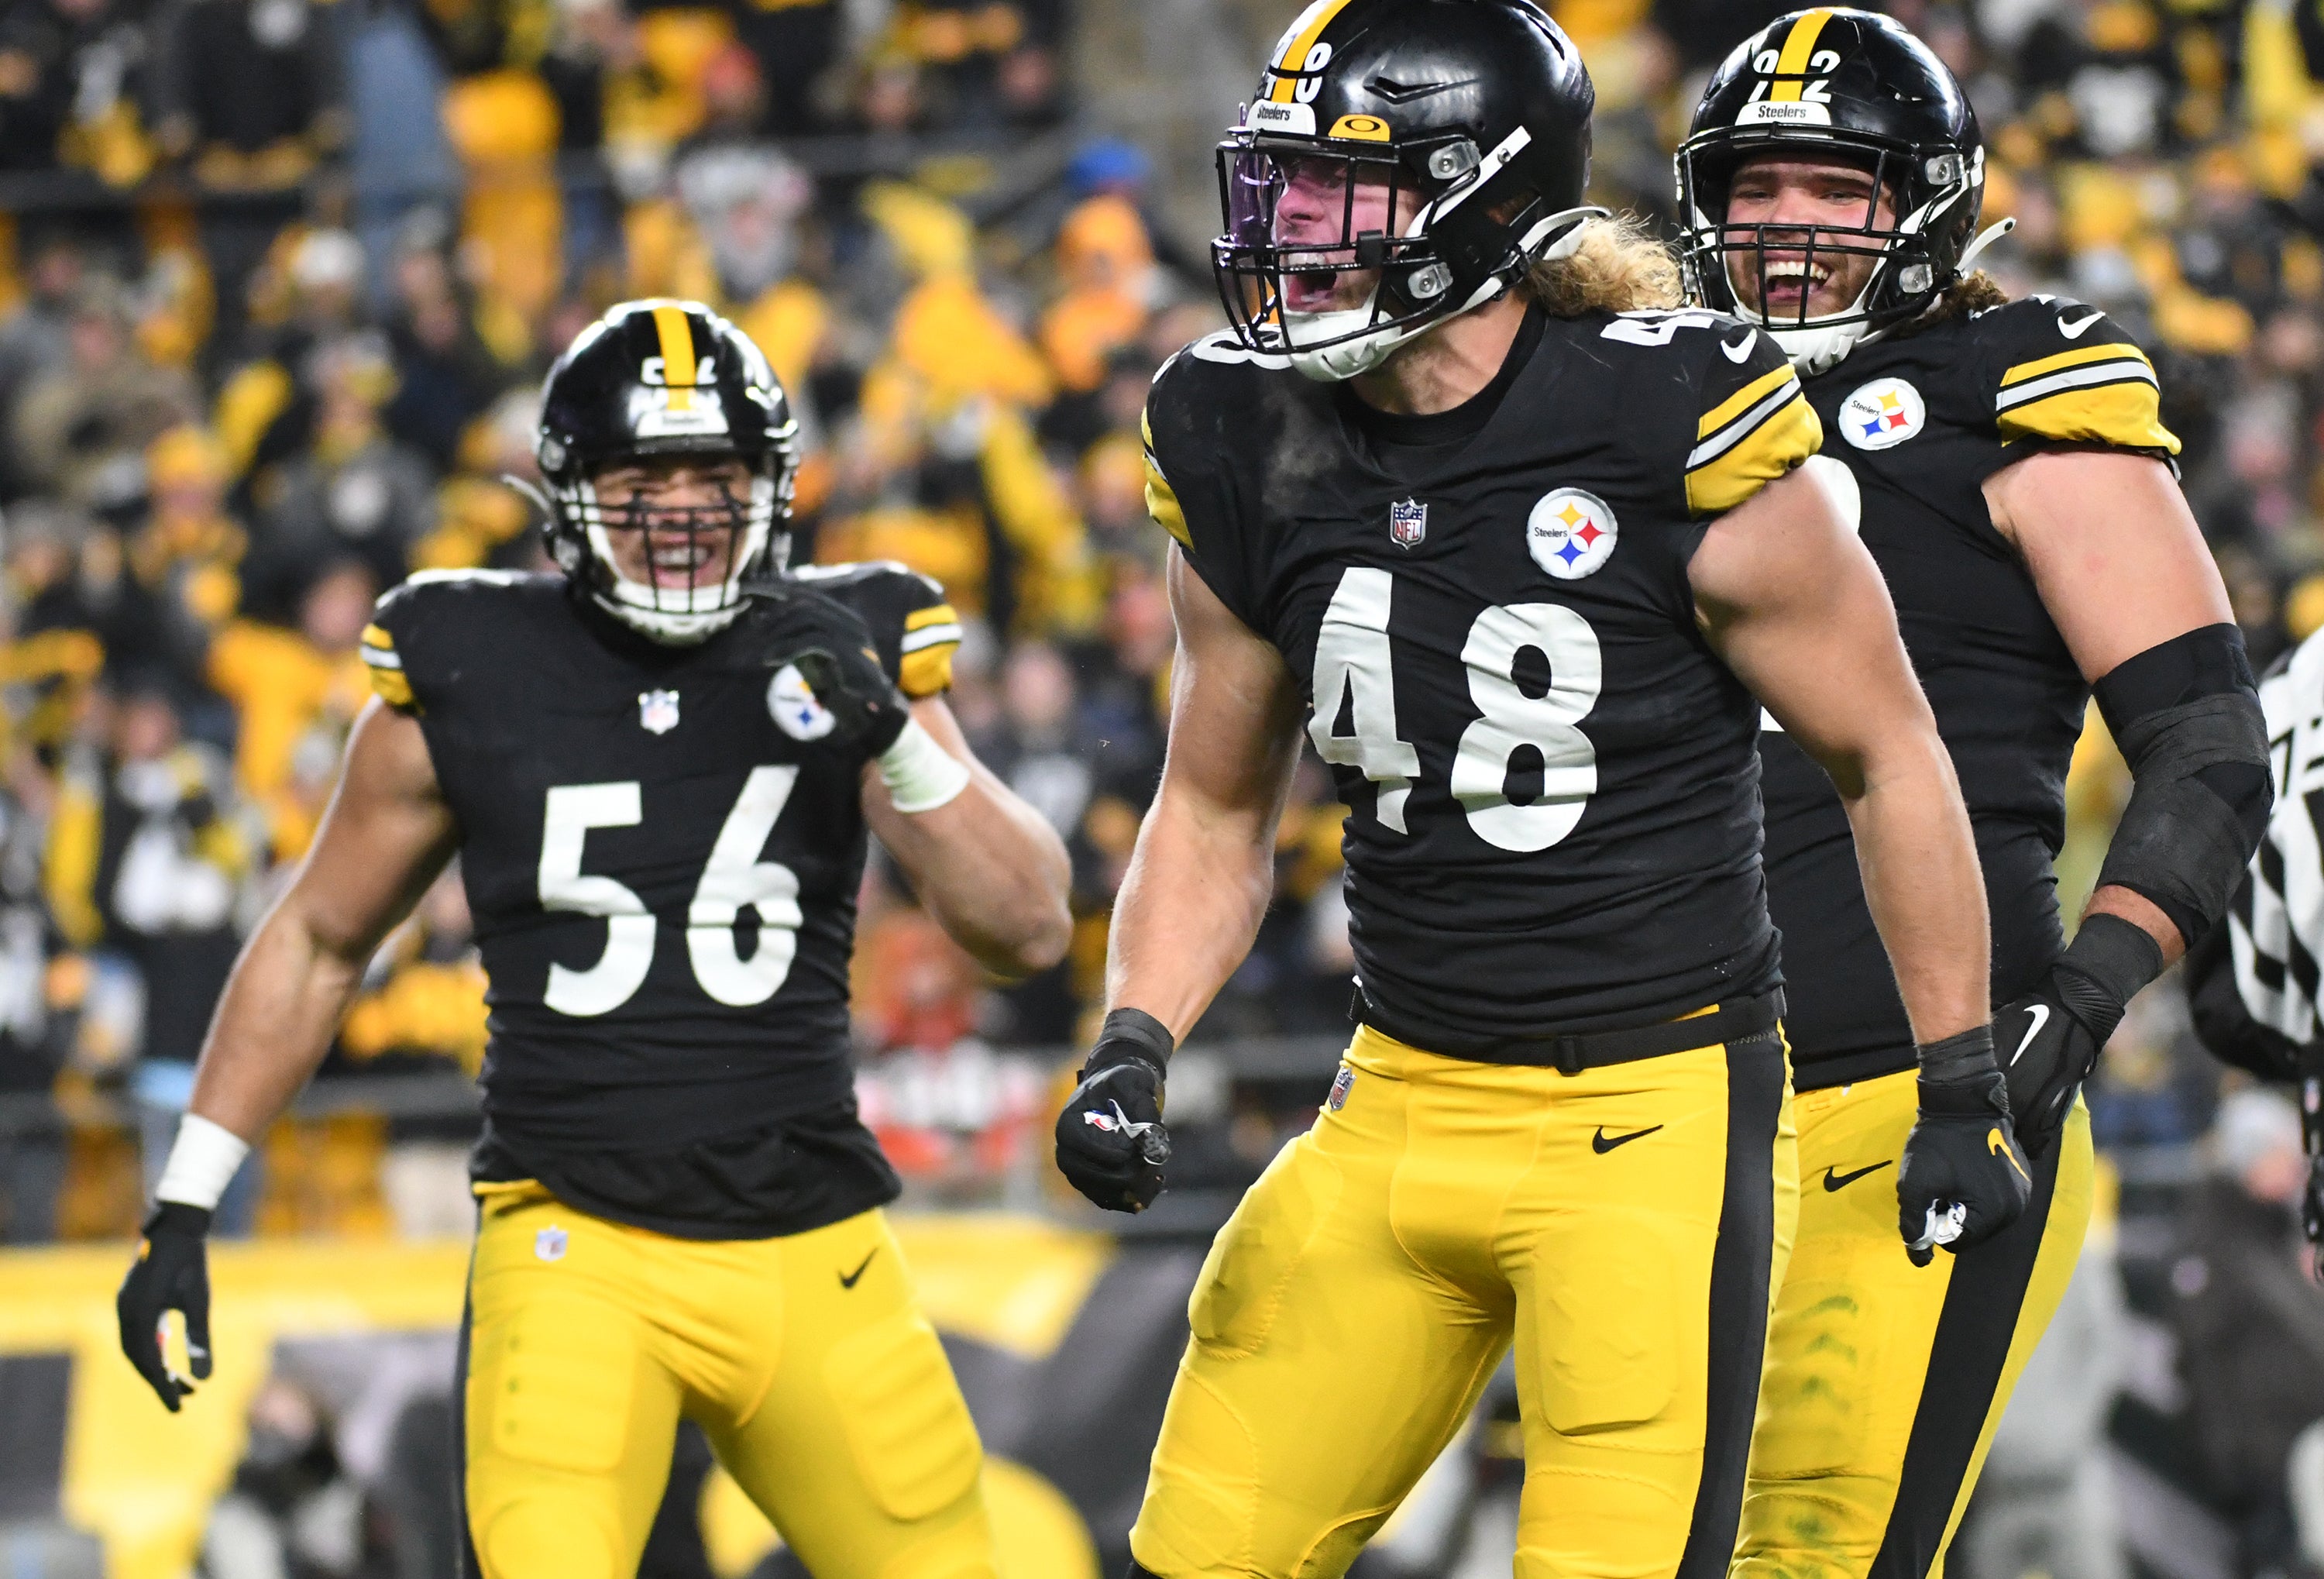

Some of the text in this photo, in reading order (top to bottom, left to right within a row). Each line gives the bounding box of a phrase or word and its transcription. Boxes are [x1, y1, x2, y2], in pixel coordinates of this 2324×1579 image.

[1747, 49, 1841, 104] 92
[1257, 104, 1291, 121] Steelers
[1757, 105, 1807, 119] Steelers
[1851, 399, 1880, 417] Steelers
[1395, 521, 1419, 542] NFL
[1534, 526, 1568, 538] Steelers
[1307, 566, 1603, 853] 48
[538, 763, 804, 1018] 56
